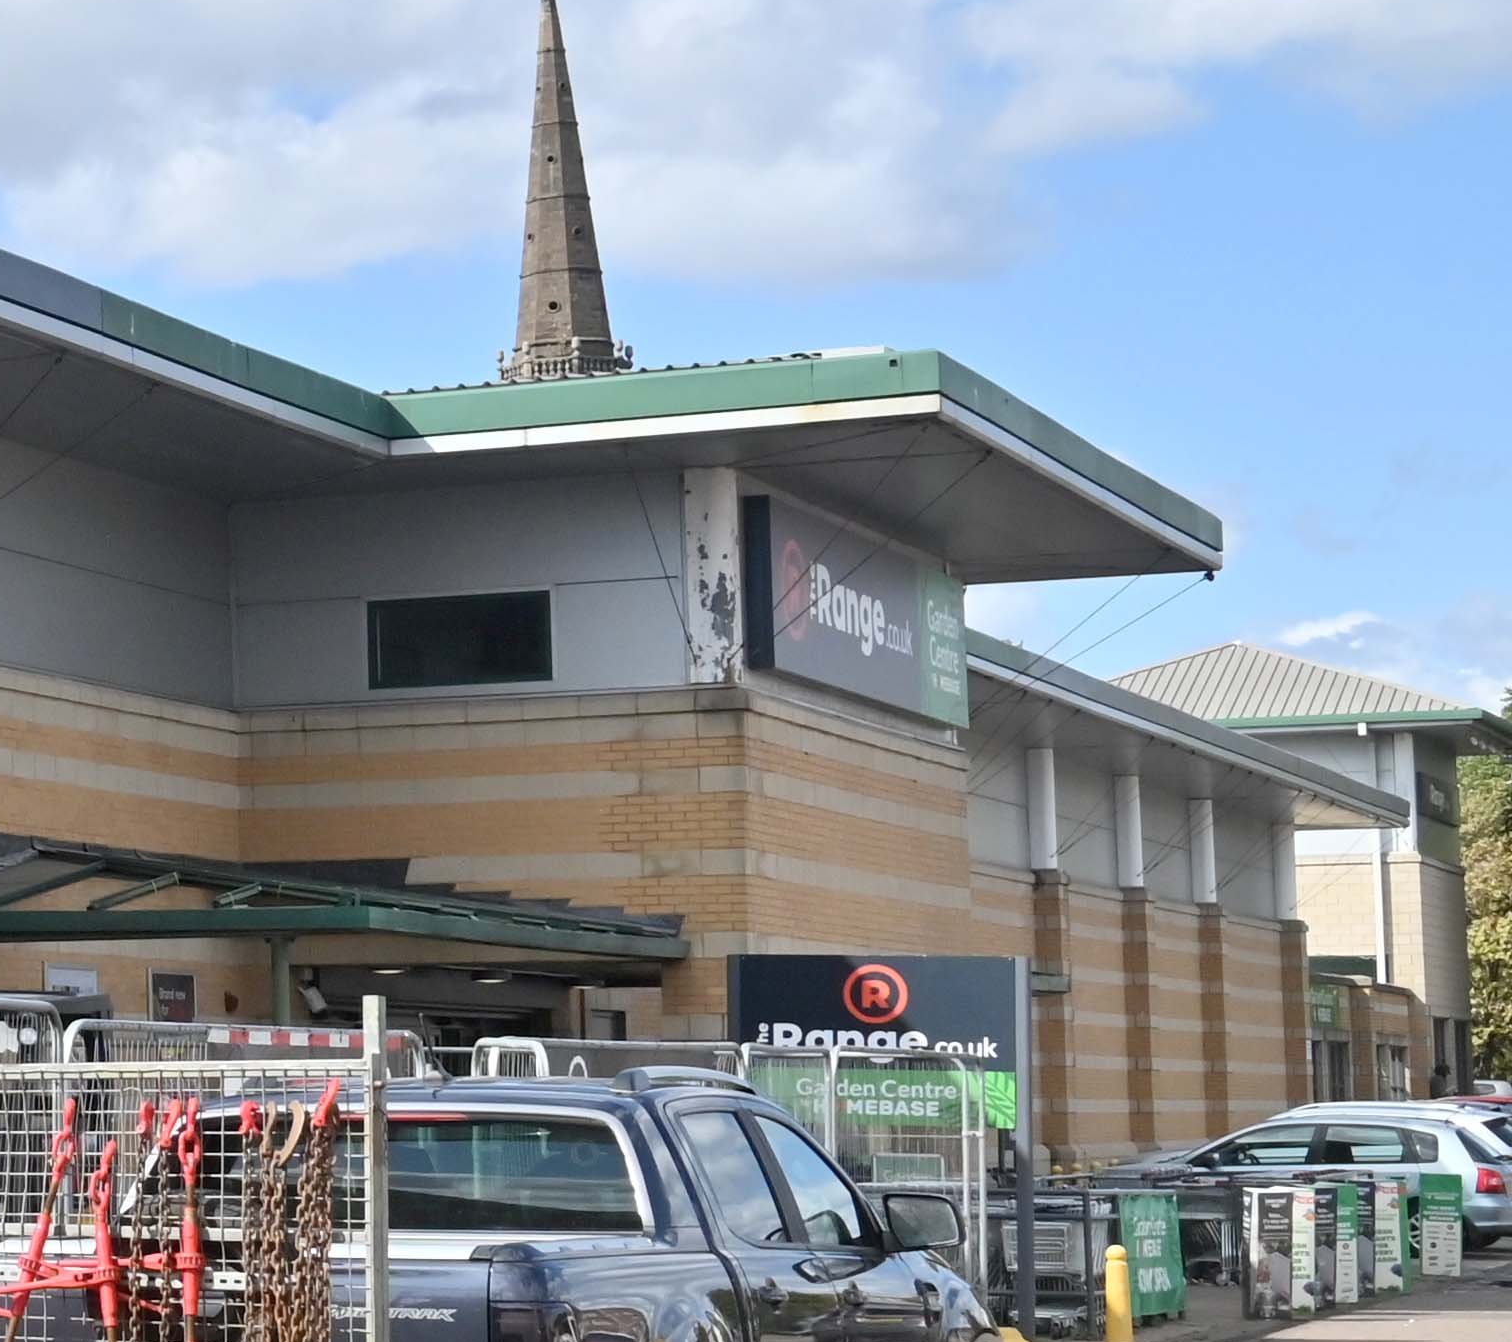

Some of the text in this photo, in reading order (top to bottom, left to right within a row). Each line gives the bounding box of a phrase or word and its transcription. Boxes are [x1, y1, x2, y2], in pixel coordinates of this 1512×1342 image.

[796, 1077, 957, 1100] Gaden Centre
[813, 1099, 940, 1117] HMEBASE
